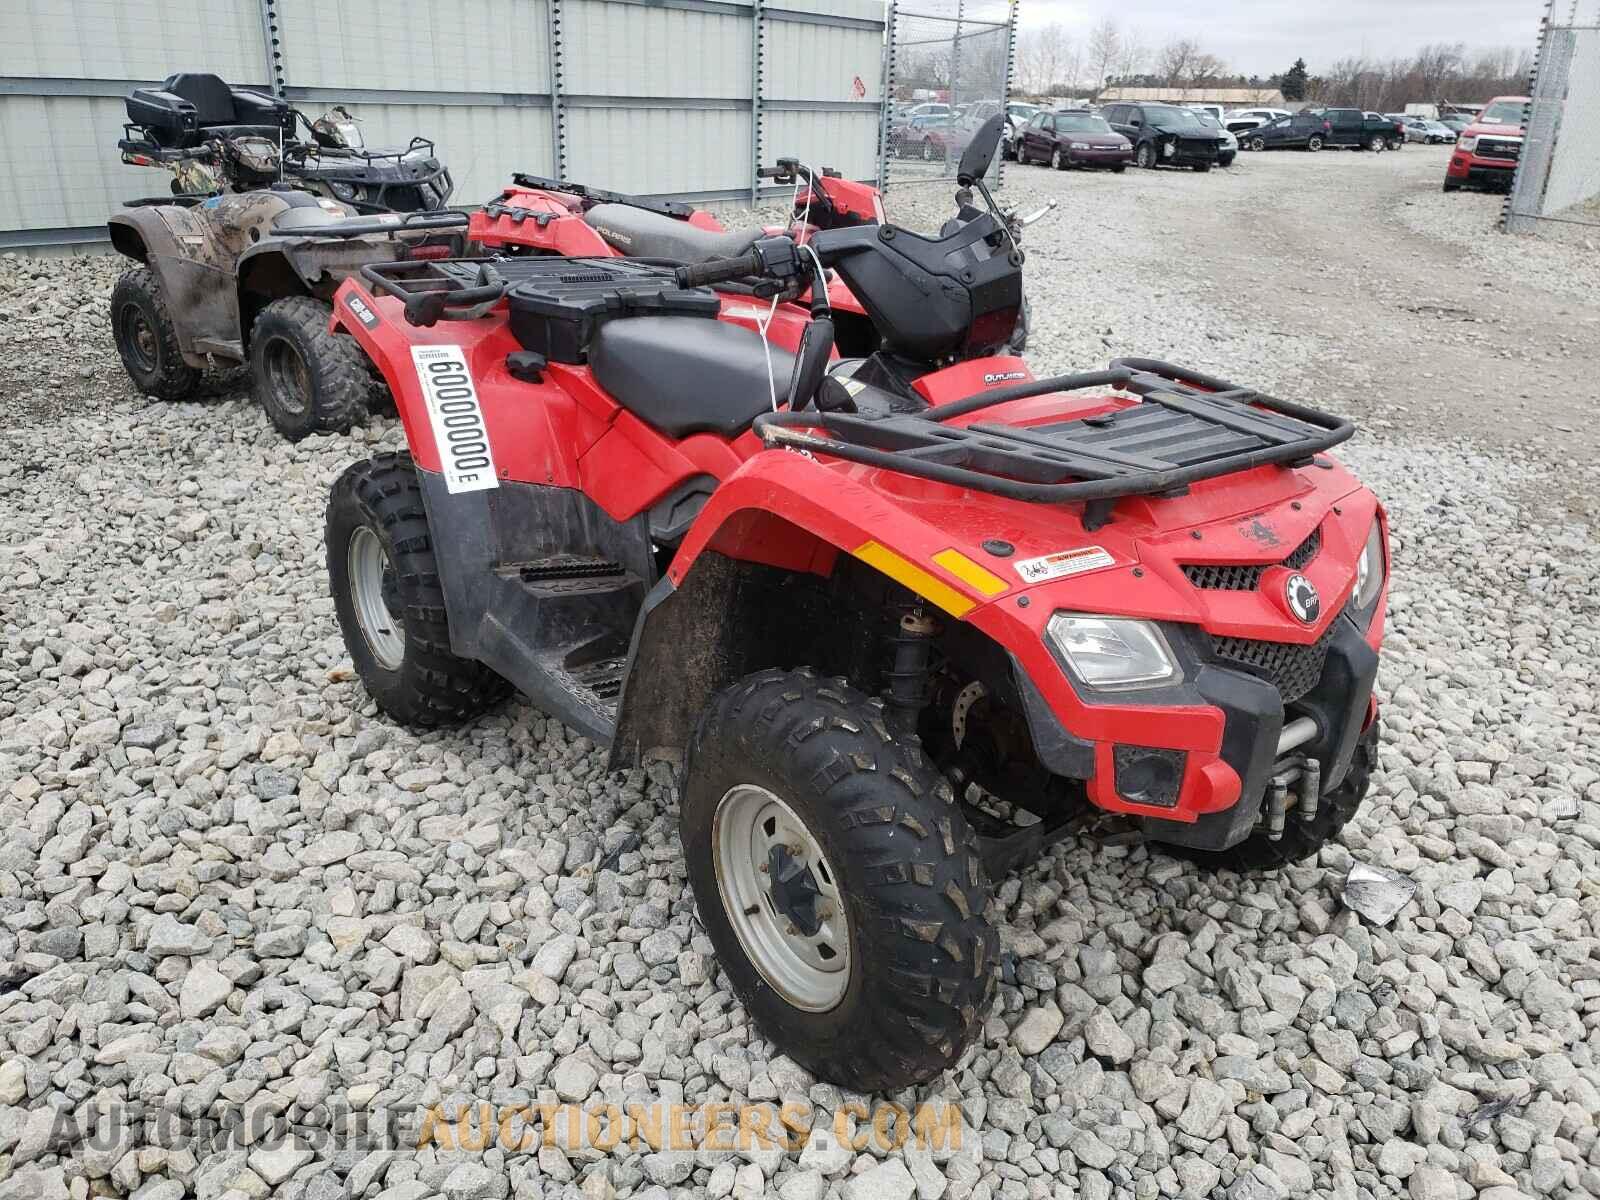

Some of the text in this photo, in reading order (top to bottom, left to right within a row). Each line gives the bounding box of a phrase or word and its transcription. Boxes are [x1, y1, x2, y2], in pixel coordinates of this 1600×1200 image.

[596, 226, 632, 245] POLARIS
[428, 361, 490, 470] 60000000
[1305, 594, 1318, 609] BRP
